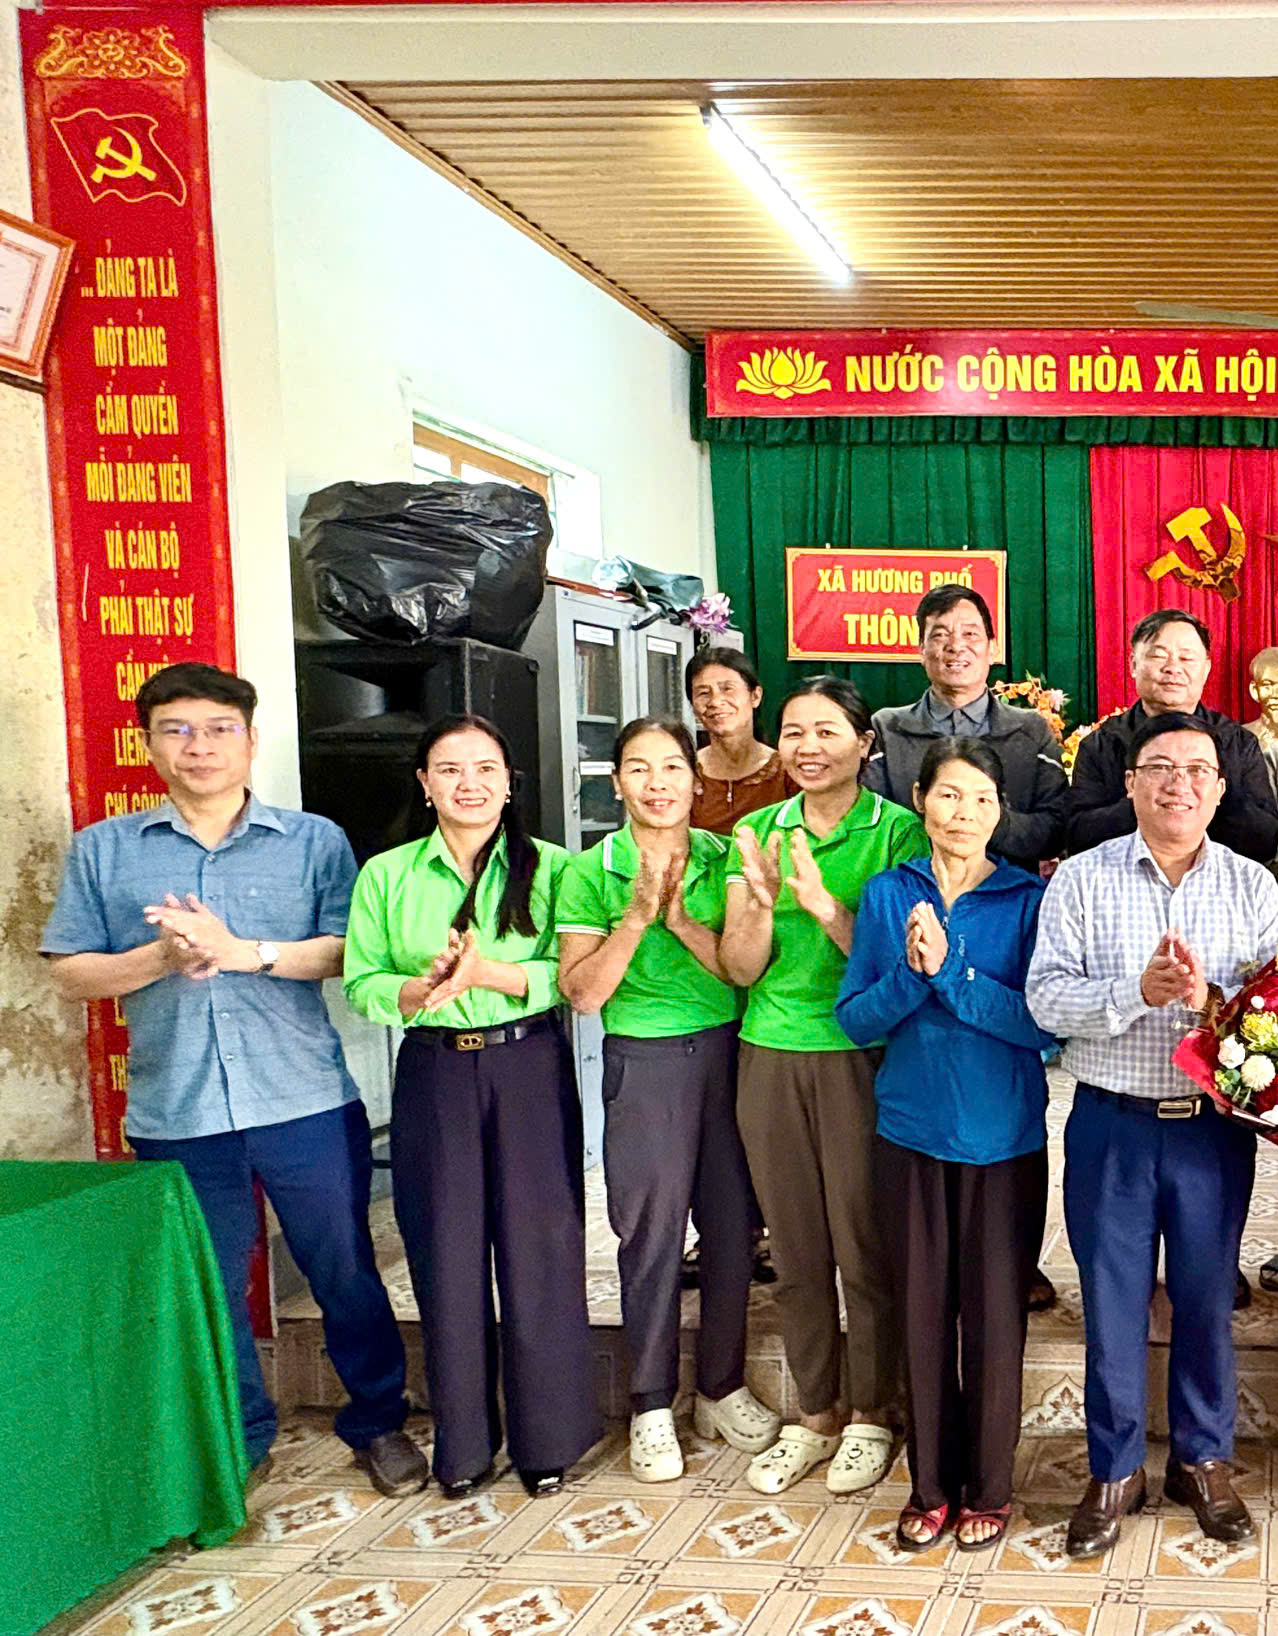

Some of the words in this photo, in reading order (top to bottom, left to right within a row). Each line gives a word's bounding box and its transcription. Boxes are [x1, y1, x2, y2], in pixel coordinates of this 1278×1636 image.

[138, 256, 158, 297] TA
[159, 248, 179, 297] LÀ
[93, 317, 124, 375] MỘT
[127, 308, 168, 367] ĐẢNG
[845, 344, 944, 393] NƯỚC
[957, 347, 1057, 400] CỘNG
[1069, 346, 1143, 393] HÒA
[1154, 348, 1203, 393] XÃ
[1215, 348, 1276, 401] HỘI
[131, 379, 179, 440] QUYỀN
[116, 445, 157, 503] ĐẢNG
[158, 454, 192, 503] VIÊN
[104, 520, 126, 570] VÀ
[127, 520, 158, 570] CÁN
[159, 520, 180, 579] BỘ
[817, 565, 847, 593] XÃ
[852, 568, 923, 594] HƯƠNG
[100, 579, 134, 636] PHẢI
[135, 587, 170, 646] THẬT
[173, 592, 195, 646] SỰ
